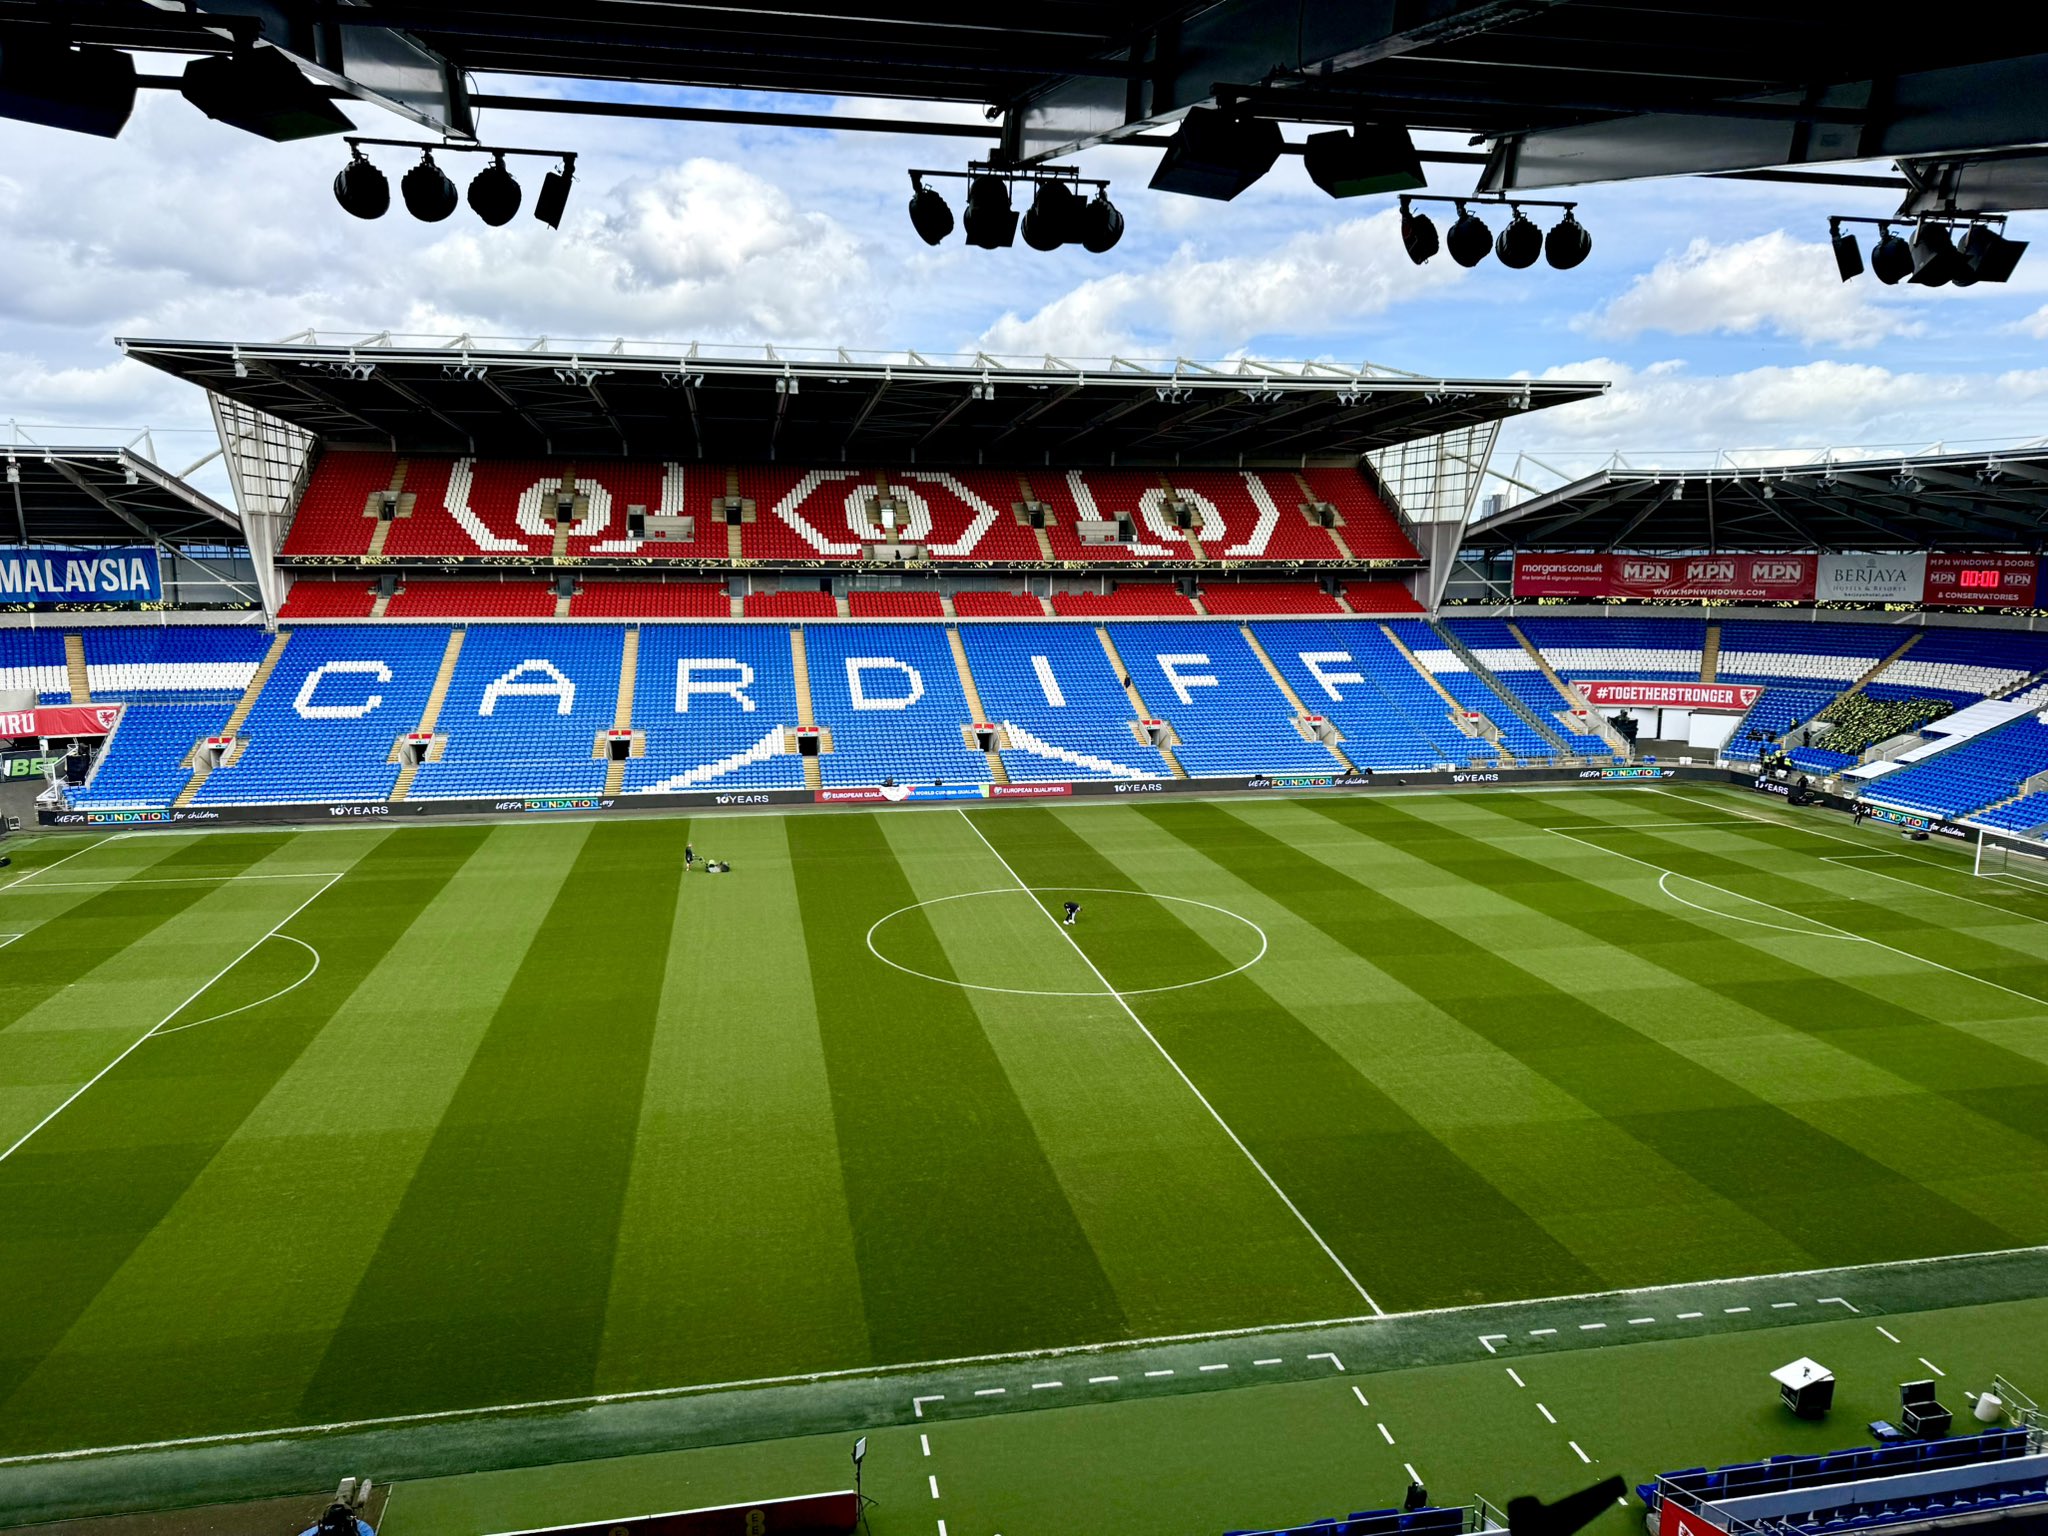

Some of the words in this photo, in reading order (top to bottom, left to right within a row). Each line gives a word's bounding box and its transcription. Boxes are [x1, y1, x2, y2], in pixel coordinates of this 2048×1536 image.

[0, 558, 150, 593] MALAYSIA
[1834, 569, 1906, 584] BERJAYA
[1960, 570, 1999, 587] 00:00
[1653, 588, 1766, 597] WWW.MPNWINDOWS.COM
[1945, 592, 2019, 600] CONSERVATORIES
[1597, 687, 1733, 704] #TOGETHERSTRONGER
[1580, 770, 1600, 778] UEFA
[1271, 778, 1333, 786] FOUNDATION
[495, 802, 522, 810] UEFA
[88, 812, 170, 822] FOUNDATION
[188, 811, 219, 819] children
[1871, 808, 1929, 829] FOUNDATION
